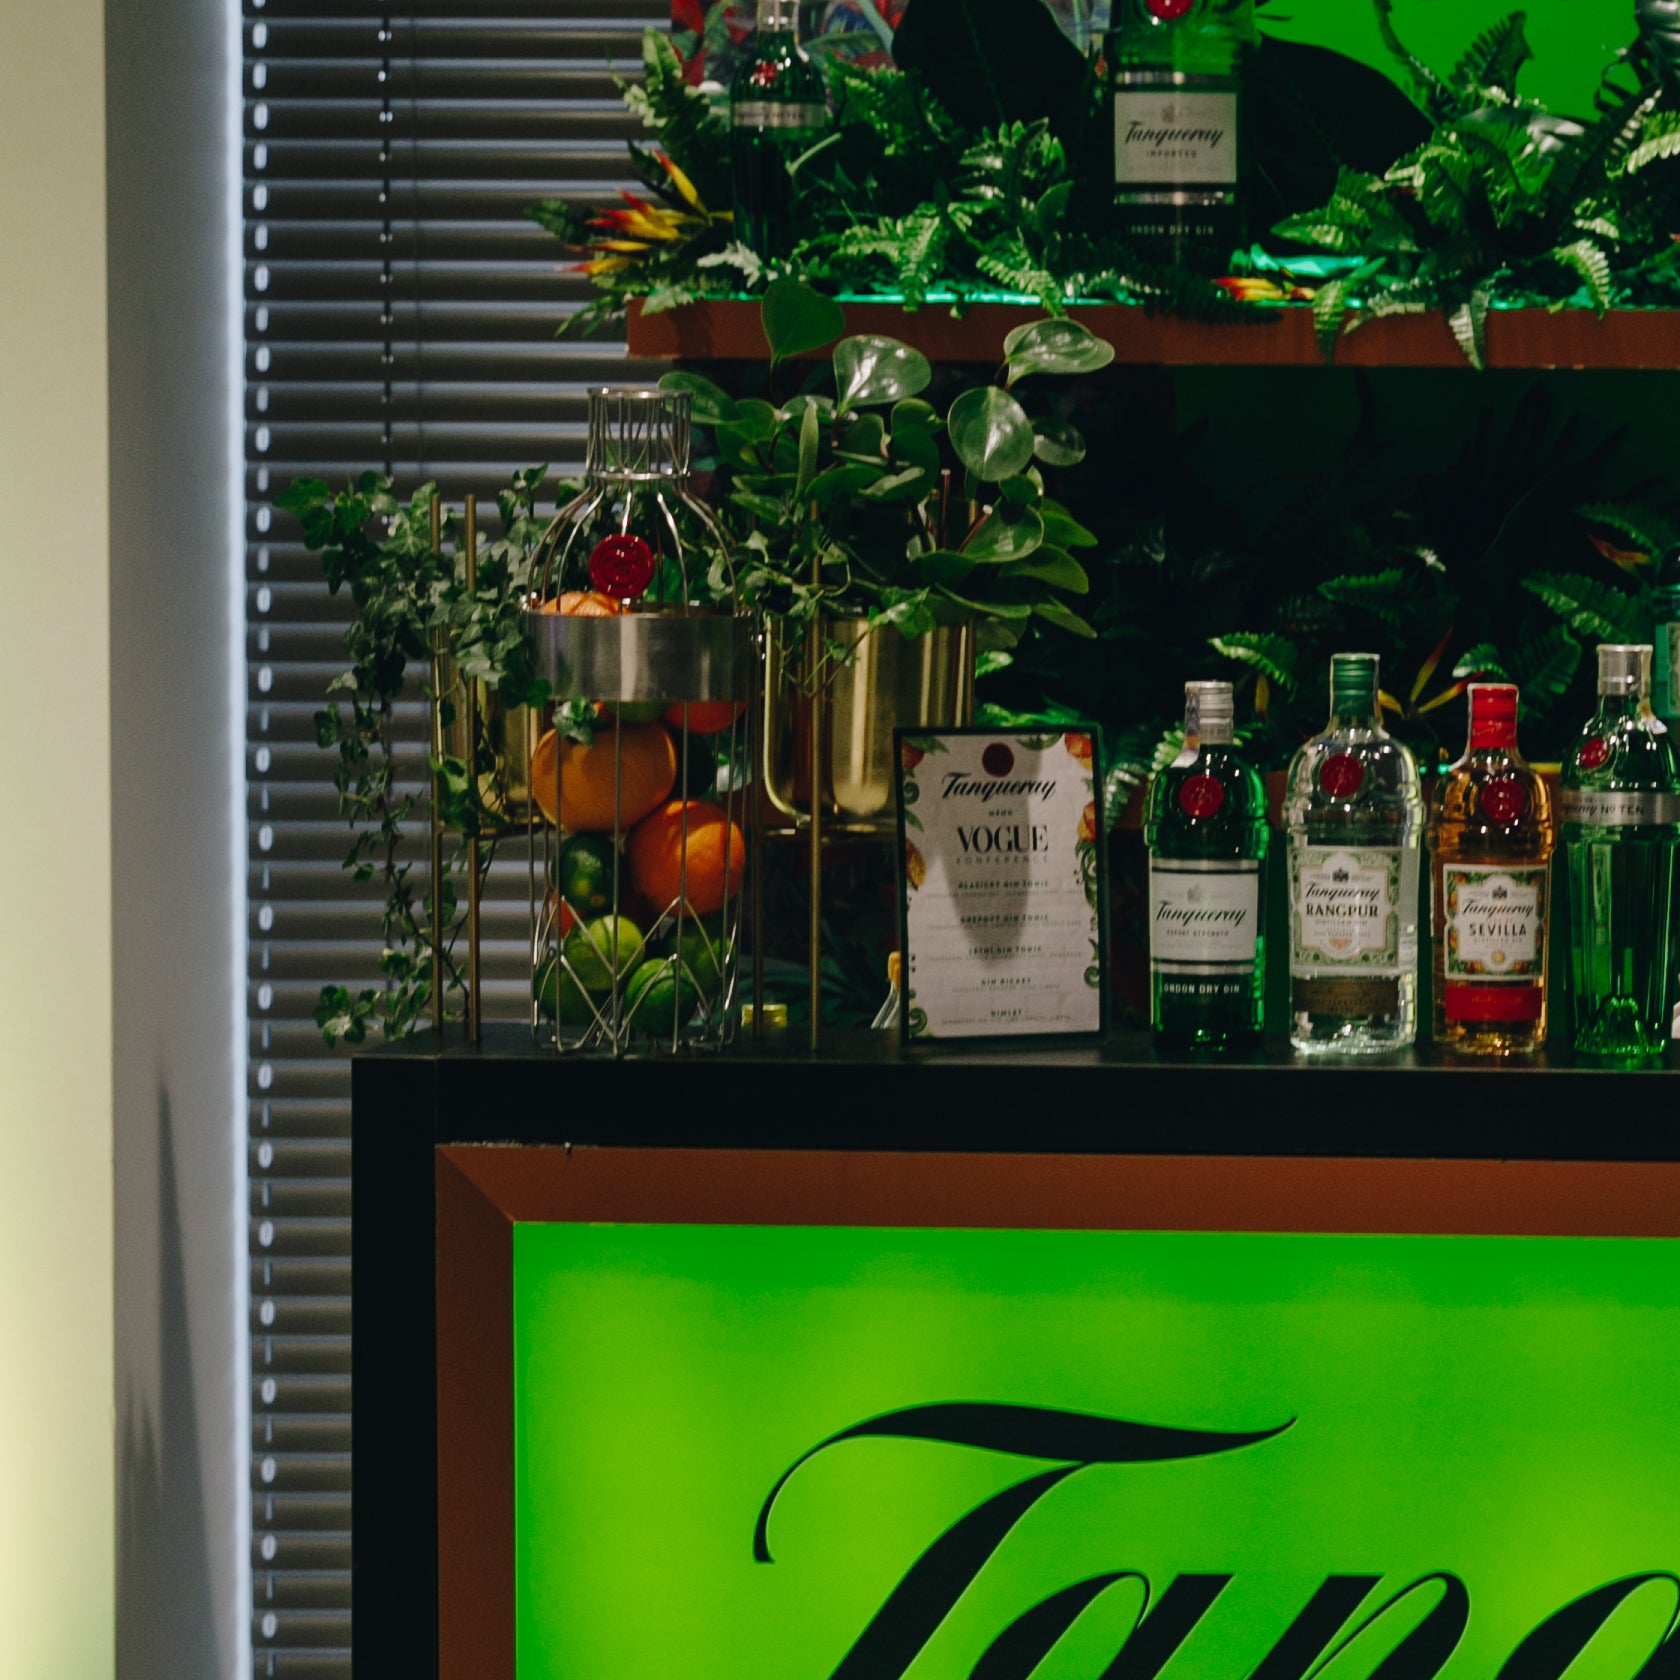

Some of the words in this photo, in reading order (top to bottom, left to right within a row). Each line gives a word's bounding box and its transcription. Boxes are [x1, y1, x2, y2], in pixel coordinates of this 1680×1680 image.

[1125, 120, 1224, 148] Tanqueray
[942, 772, 1056, 802] Tanqueray
[1621, 805, 1645, 816] TEN
[957, 825, 1049, 854] VOGUE
[1305, 882, 1380, 901] Tanqueray
[1156, 900, 1247, 927] Tanqueray
[1306, 904, 1379, 917] RANGPUR
[1461, 898, 1535, 918] Tanqueray
[1469, 923, 1527, 937] SEVILLA
[1199, 983, 1220, 995] DRY
[1223, 983, 1241, 994] GIN
